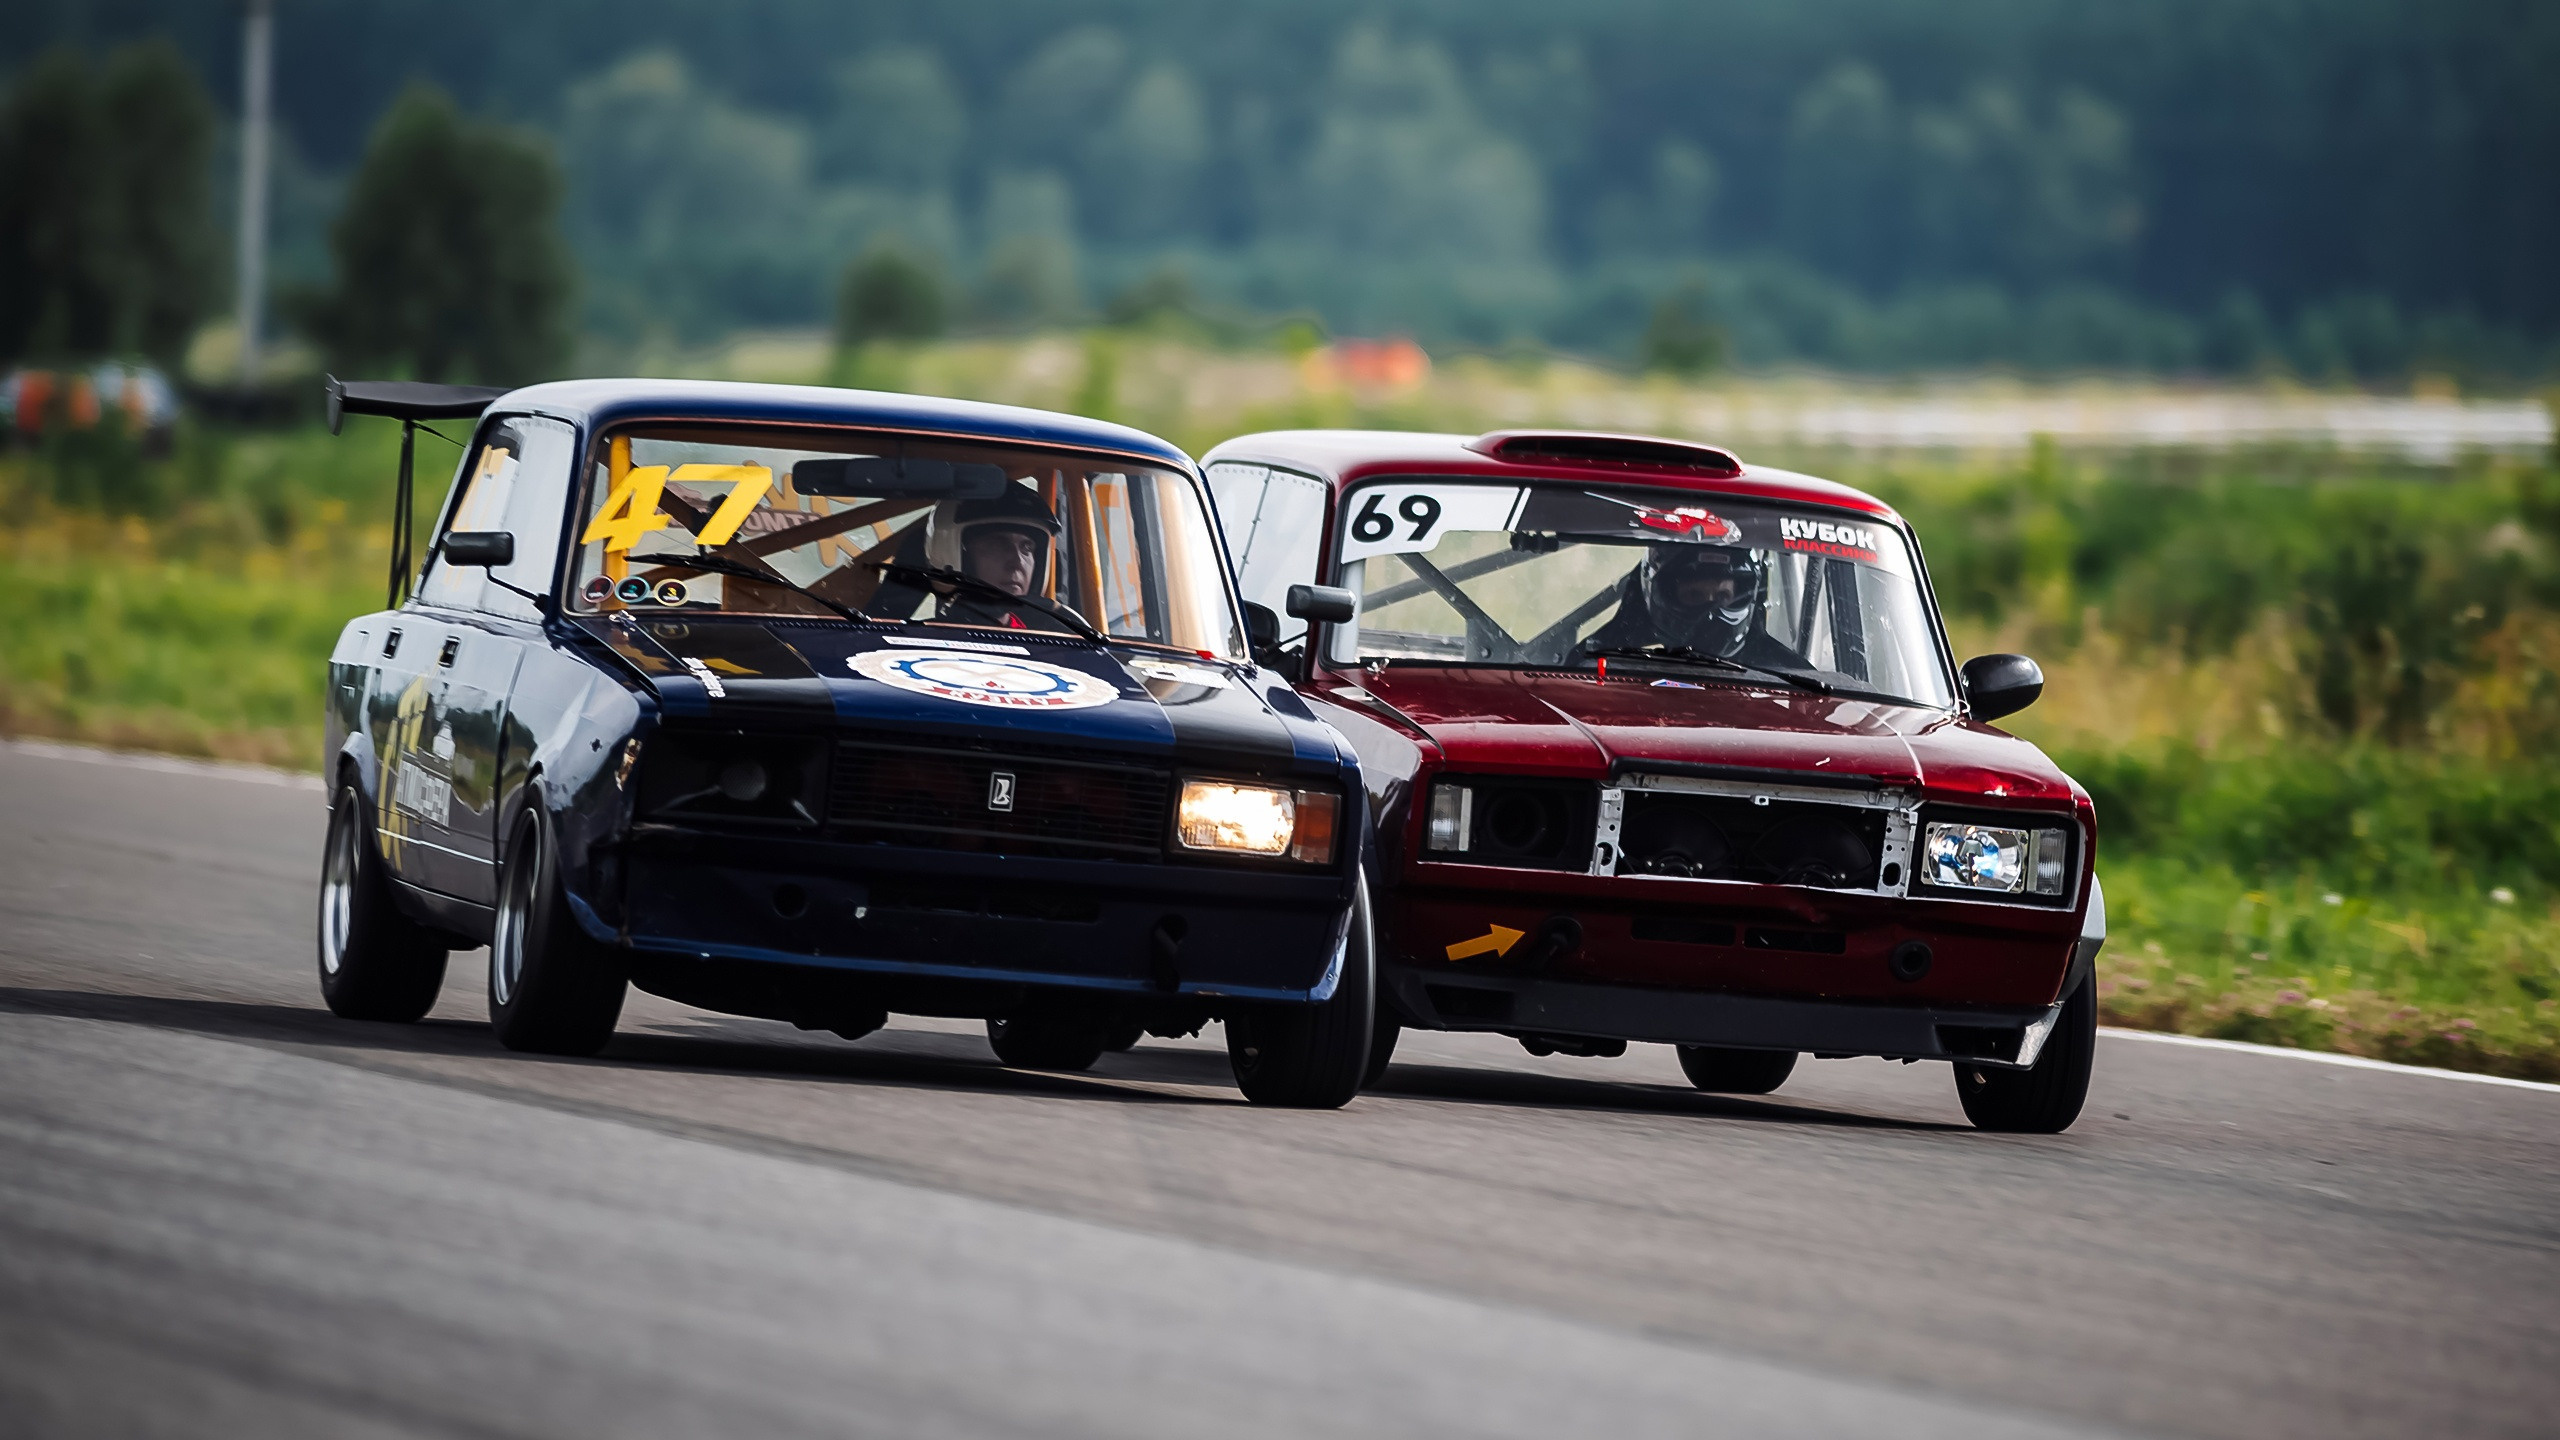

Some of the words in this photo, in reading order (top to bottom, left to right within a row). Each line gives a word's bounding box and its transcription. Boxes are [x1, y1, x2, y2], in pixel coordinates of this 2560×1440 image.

[580, 463, 772, 554] 47
[1351, 494, 1441, 543] 69
[1780, 517, 1877, 551] КУБОК
[1783, 538, 1878, 564] КЛАССИКИ
